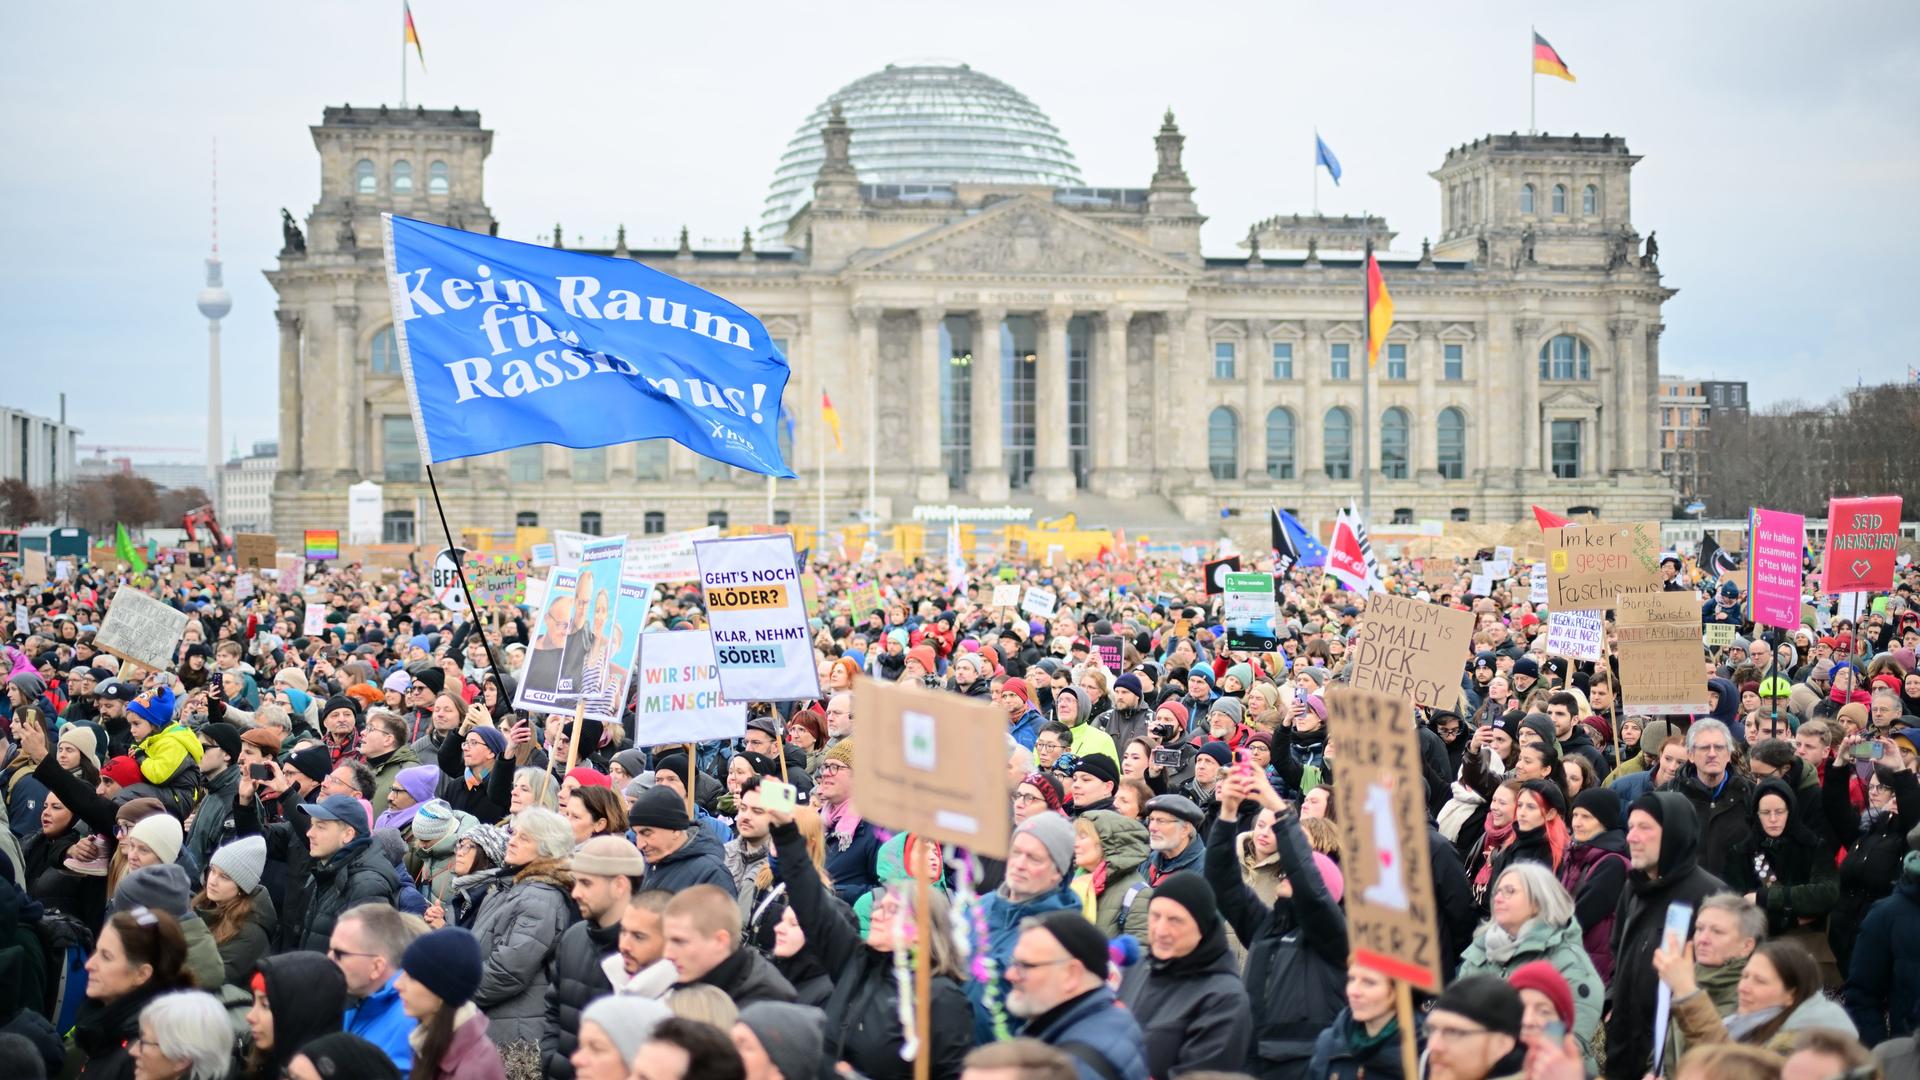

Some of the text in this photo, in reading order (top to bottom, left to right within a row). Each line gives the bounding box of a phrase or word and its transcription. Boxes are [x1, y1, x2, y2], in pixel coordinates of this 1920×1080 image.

[397, 264, 754, 351] Kein Raum
[1851, 513, 1883, 530] SEID
[1560, 527, 1617, 548] Imker
[1759, 530, 1795, 545] Wir halten
[1833, 532, 1898, 552] MENSCHEN
[1759, 546, 1798, 560] zusammen.
[1576, 553, 1628, 574] gegen
[1780, 562, 1797, 574] Welt
[705, 571, 749, 585] GEHT'S
[752, 568, 795, 582] NOCH
[1758, 571, 1796, 588] bleibt bunt.
[709, 587, 779, 606] BLÖDER?
[1371, 595, 1455, 640] RACISM IS
[1647, 607, 1692, 621] Barista
[714, 627, 805, 643] KLAR, NEHMT
[1364, 621, 1430, 653] SMALL
[1549, 625, 1563, 637] UND
[1579, 629, 1600, 643] NAZIS
[719, 646, 776, 664] SÖDER!
[1359, 641, 1416, 675] DICK
[645, 664, 719, 684] WIR SIND
[1355, 666, 1446, 707] ENERGY
